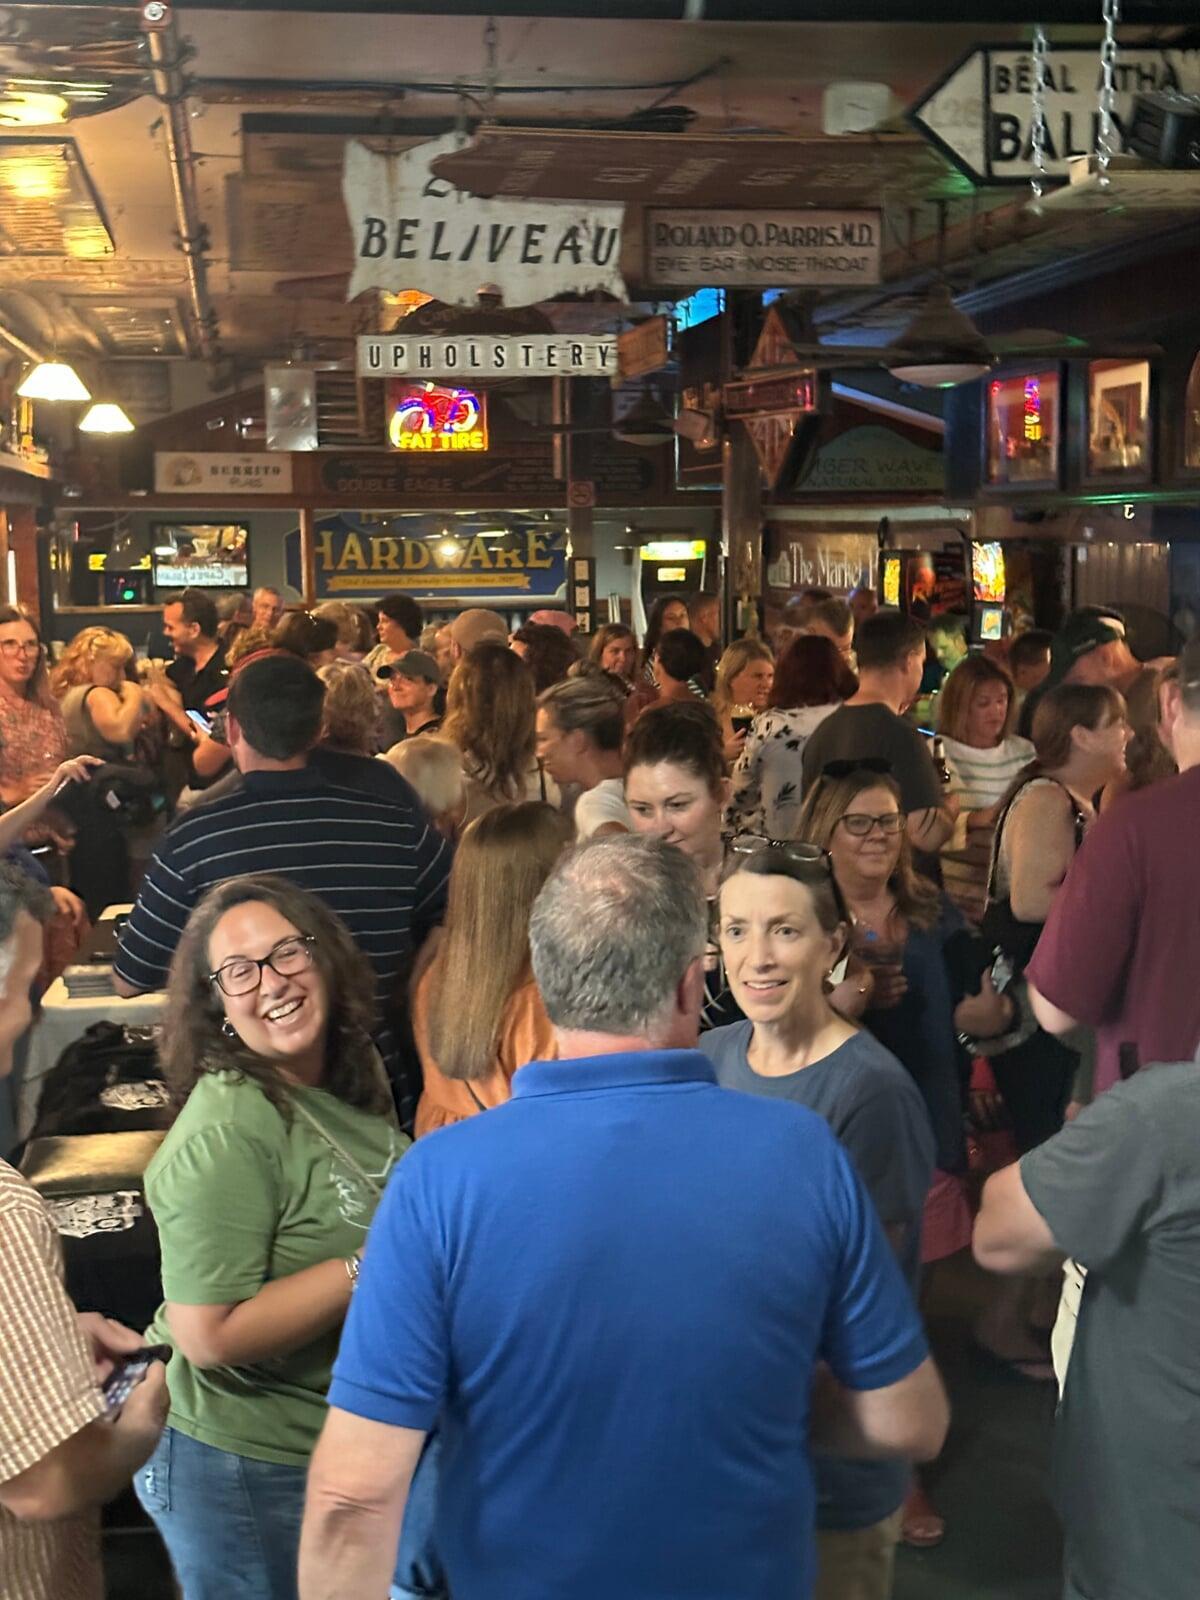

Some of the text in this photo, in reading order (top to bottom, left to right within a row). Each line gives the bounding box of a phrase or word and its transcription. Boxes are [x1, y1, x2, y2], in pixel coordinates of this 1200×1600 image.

[360, 217, 618, 266] BELIVEAU
[655, 223, 736, 248] ROLAND
[741, 222, 762, 247] O.
[369, 345, 609, 368] UPHOLSTERY
[399, 431, 484, 449] FAT TIRE
[314, 529, 555, 571] HARDWARE
[789, 541, 813, 585] The
